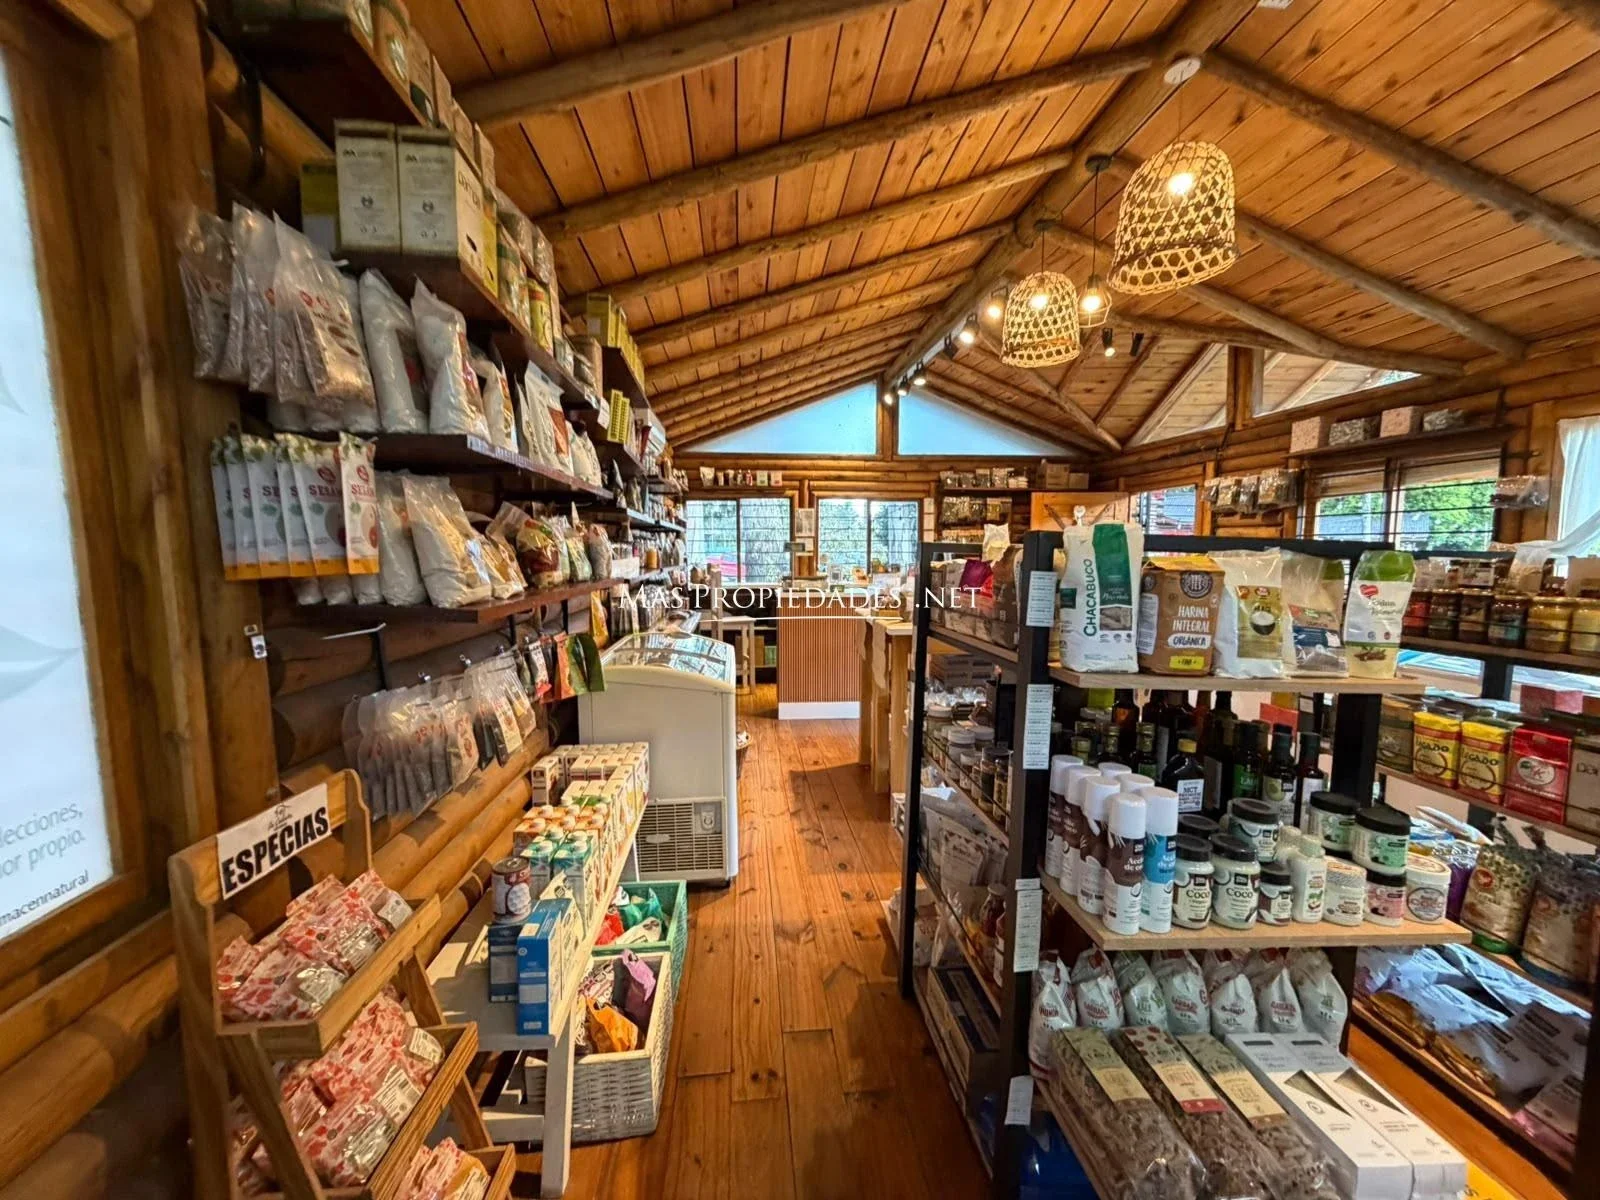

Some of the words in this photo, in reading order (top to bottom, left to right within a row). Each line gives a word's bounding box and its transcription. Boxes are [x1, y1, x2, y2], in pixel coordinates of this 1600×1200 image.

[1083, 558, 1097, 637] CHACABUCO
[1178, 604, 1208, 618] HARINA
[1172, 619, 1209, 632] INTEGRAL
[221, 806, 328, 895] ESPECIAS
[1226, 887, 1253, 898] Coco
